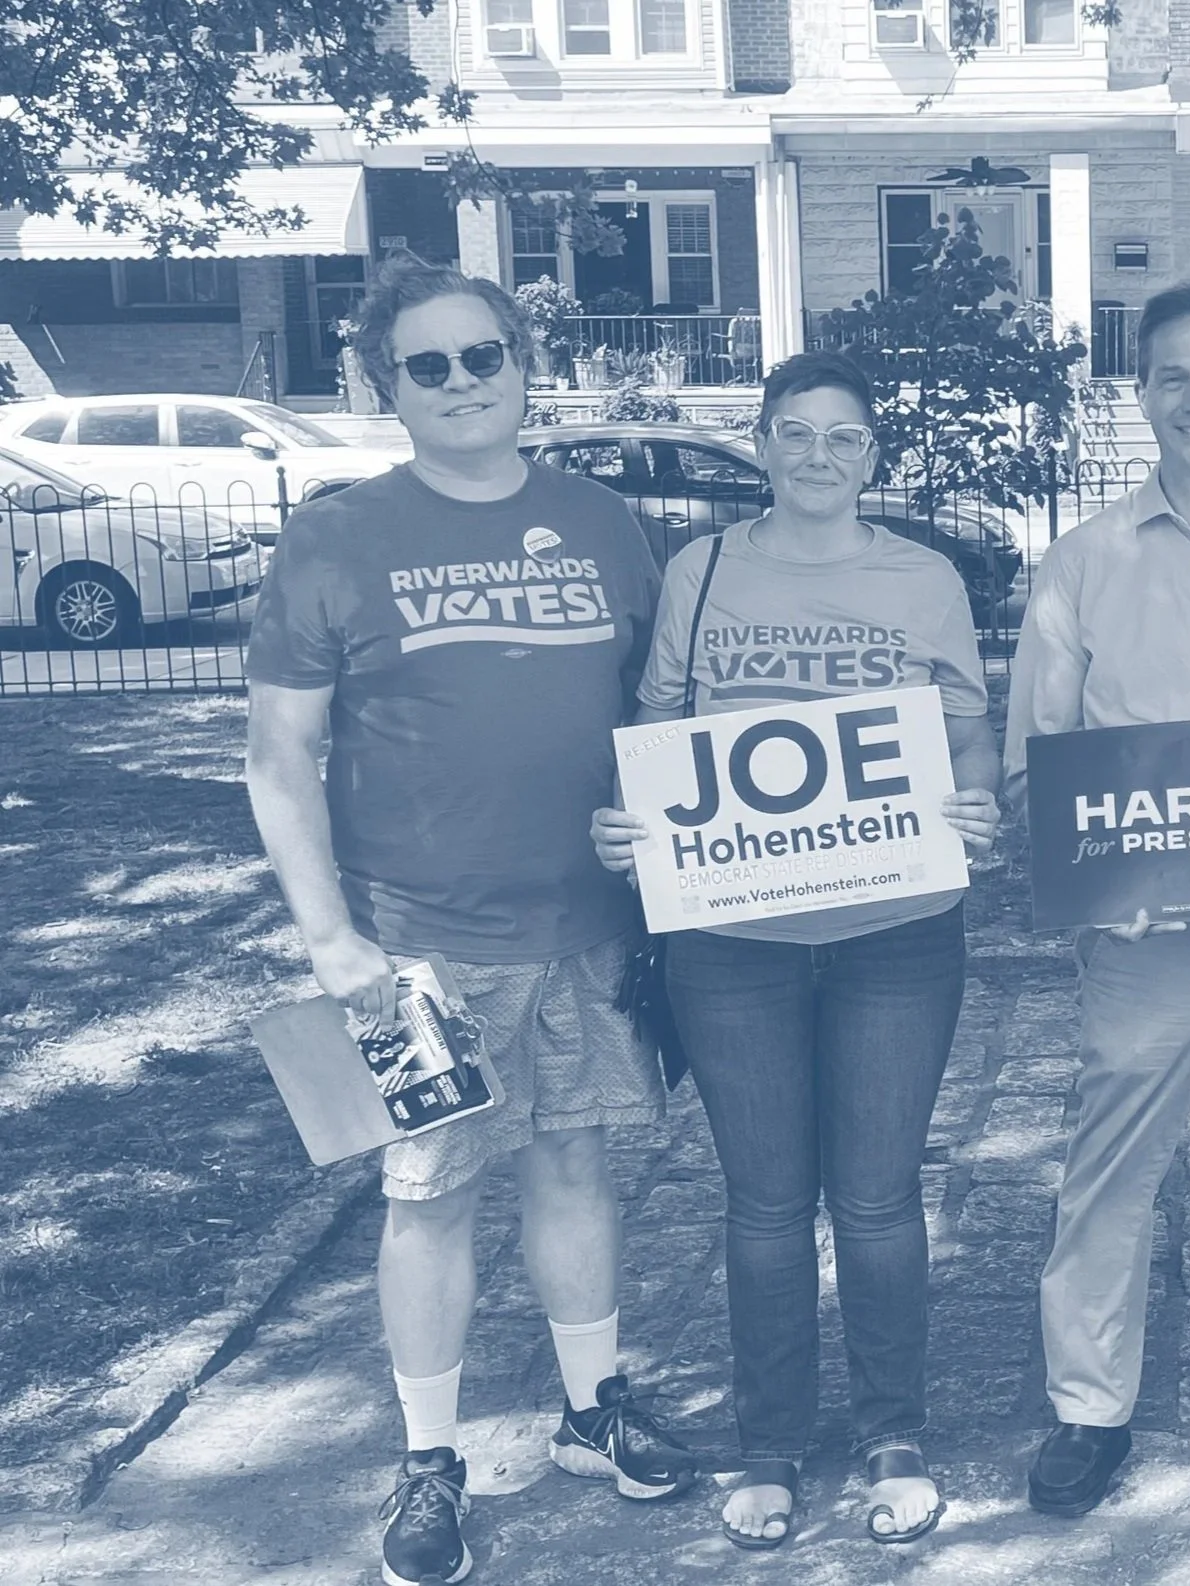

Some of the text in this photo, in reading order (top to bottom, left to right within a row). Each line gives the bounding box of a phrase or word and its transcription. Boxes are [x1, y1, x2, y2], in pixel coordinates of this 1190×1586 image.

[389, 558, 599, 592] RIVERWARDS
[394, 583, 612, 628] VOTES!
[704, 625, 907, 650] RIVERWARDS
[708, 648, 908, 688] VOTES!
[624, 726, 681, 760] RE-ELECT
[663, 705, 911, 828] JOE
[672, 803, 921, 870] Hohenstein
[1071, 837, 1116, 864] for
[678, 865, 759, 890] DEMOCRAT
[760, 857, 802, 880] STATE
[837, 845, 896, 868] DISTRICT
[707, 871, 902, 909] www.VoteHohenstein.com
